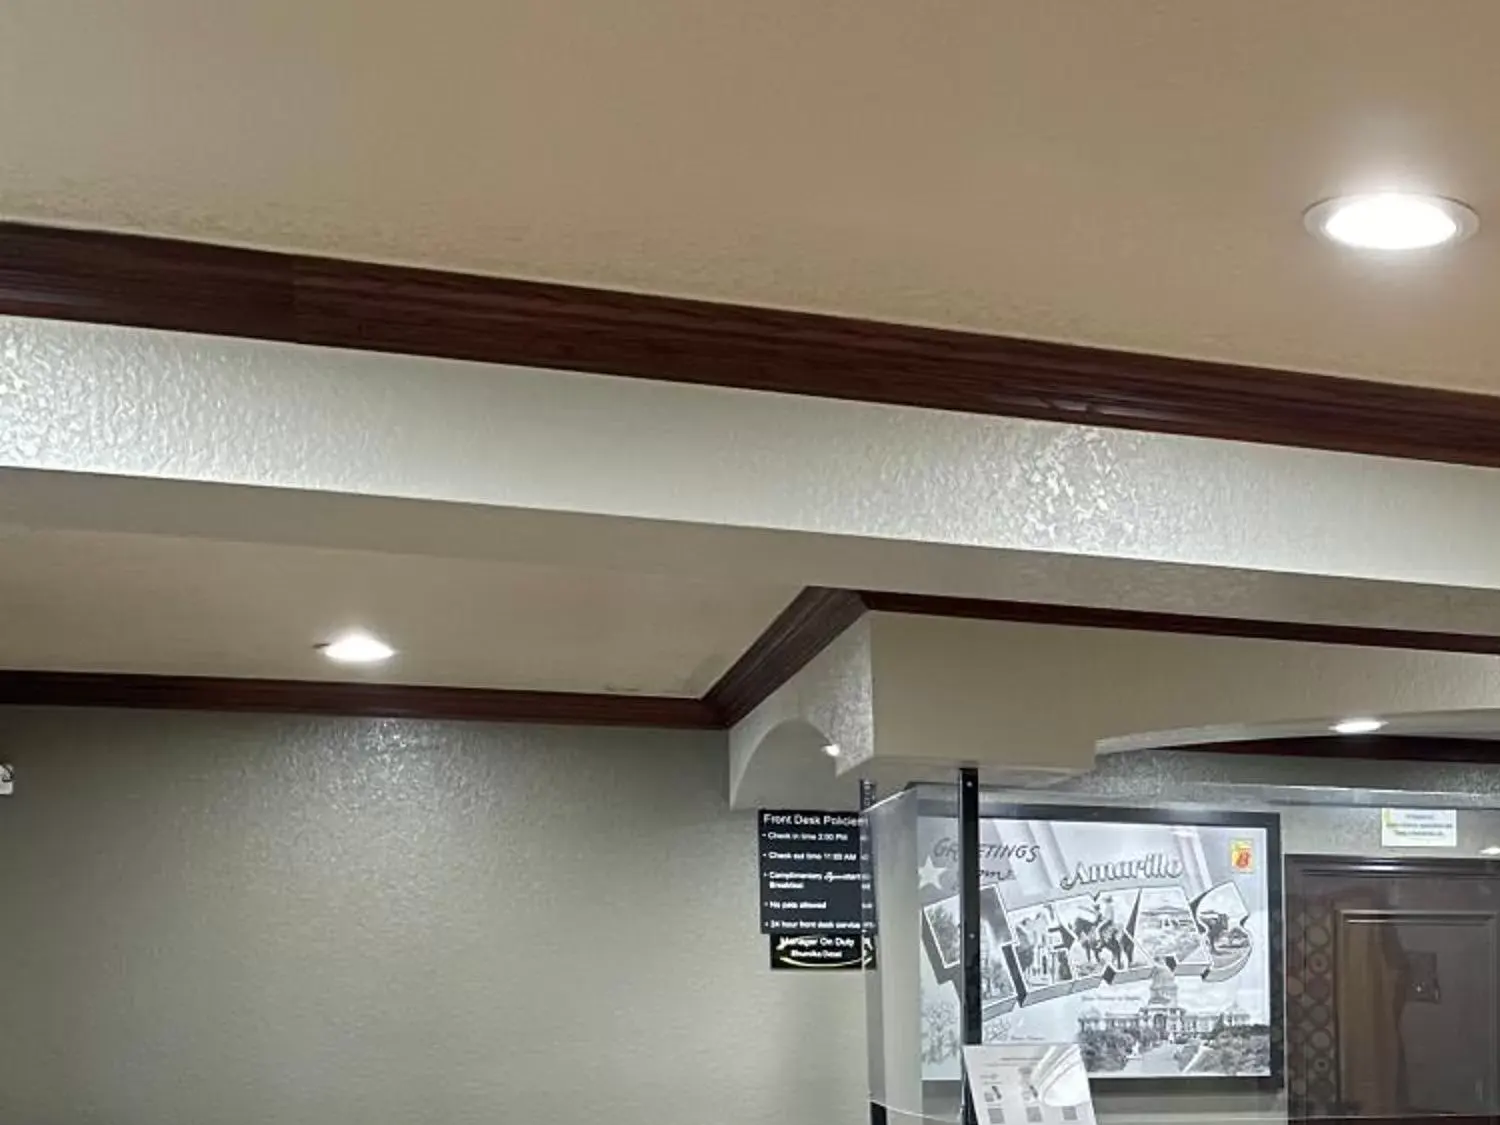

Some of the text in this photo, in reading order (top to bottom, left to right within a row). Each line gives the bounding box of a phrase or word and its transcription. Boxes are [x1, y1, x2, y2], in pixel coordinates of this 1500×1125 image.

[763, 813, 792, 825] Front
[793, 814, 820, 825] Desk
[768, 852, 792, 860] Check
[933, 838, 1040, 863] GRETINGS
[1060, 852, 1186, 890] Amarillo
[820, 937, 833, 946] On
[835, 937, 855, 948] Duty
[922, 882, 1252, 1020] TEXAS
